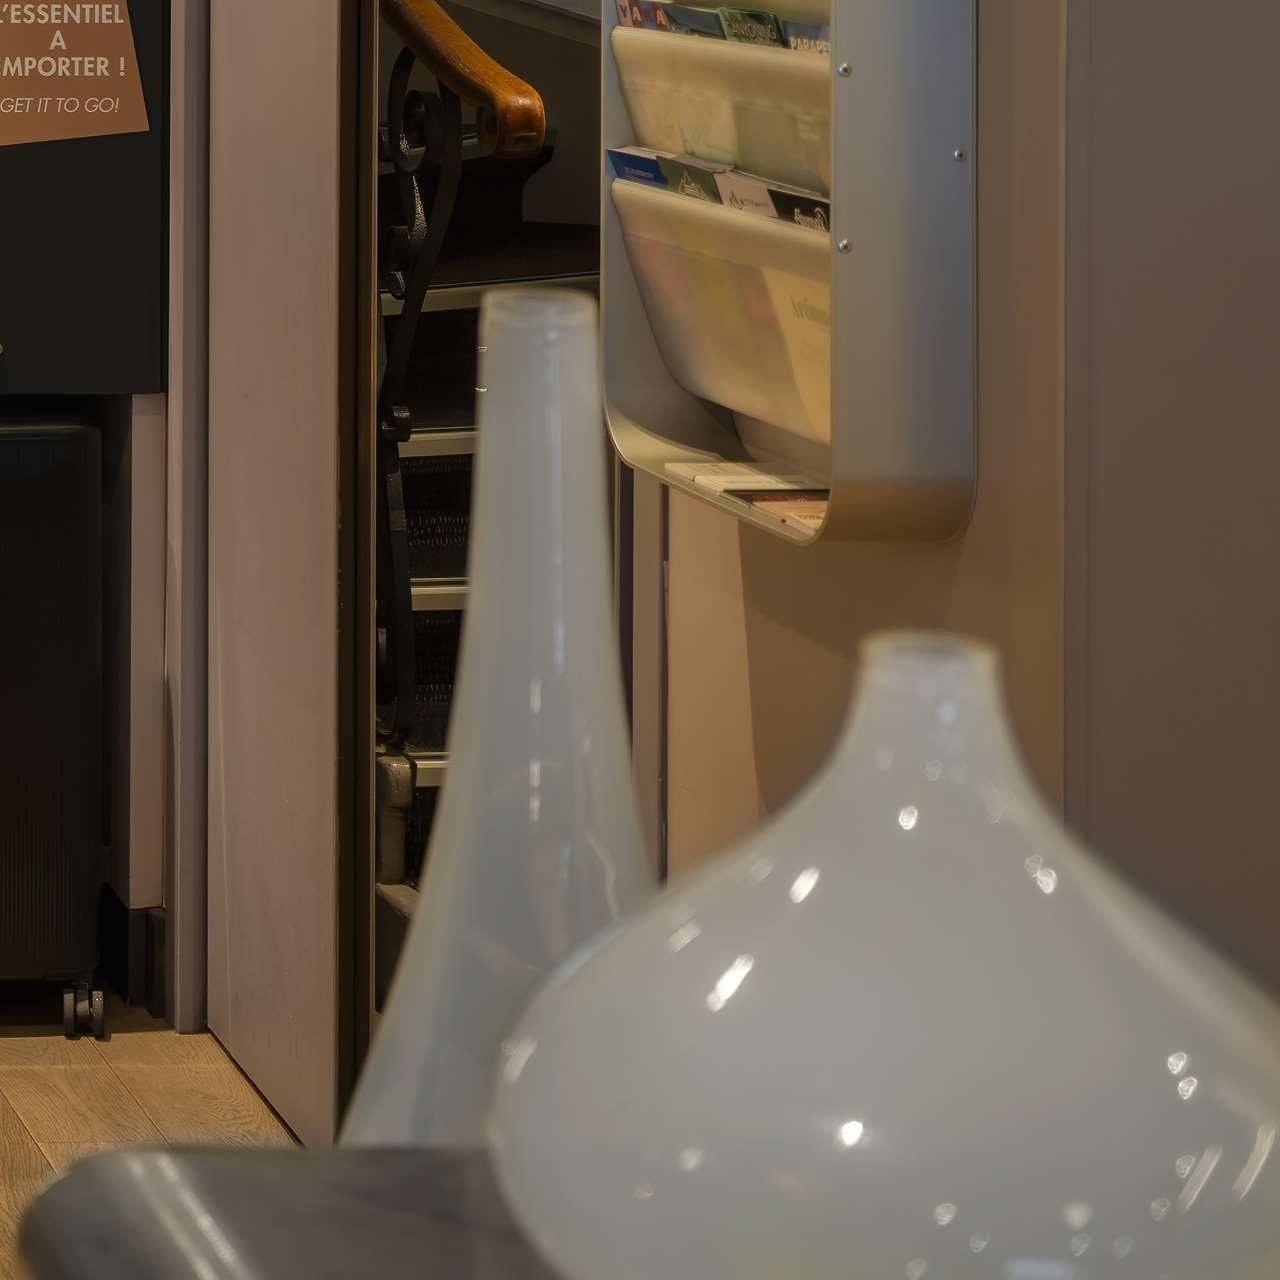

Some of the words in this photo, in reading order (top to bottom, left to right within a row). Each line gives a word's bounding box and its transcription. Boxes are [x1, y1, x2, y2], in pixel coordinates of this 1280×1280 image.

[49, 30, 67, 50] A
[119, 56, 126, 77] !
[0, 98, 34, 113] GET
[37, 98, 53, 113] IT
[56, 98, 80, 113] TO
[84, 98, 120, 113] GO!
